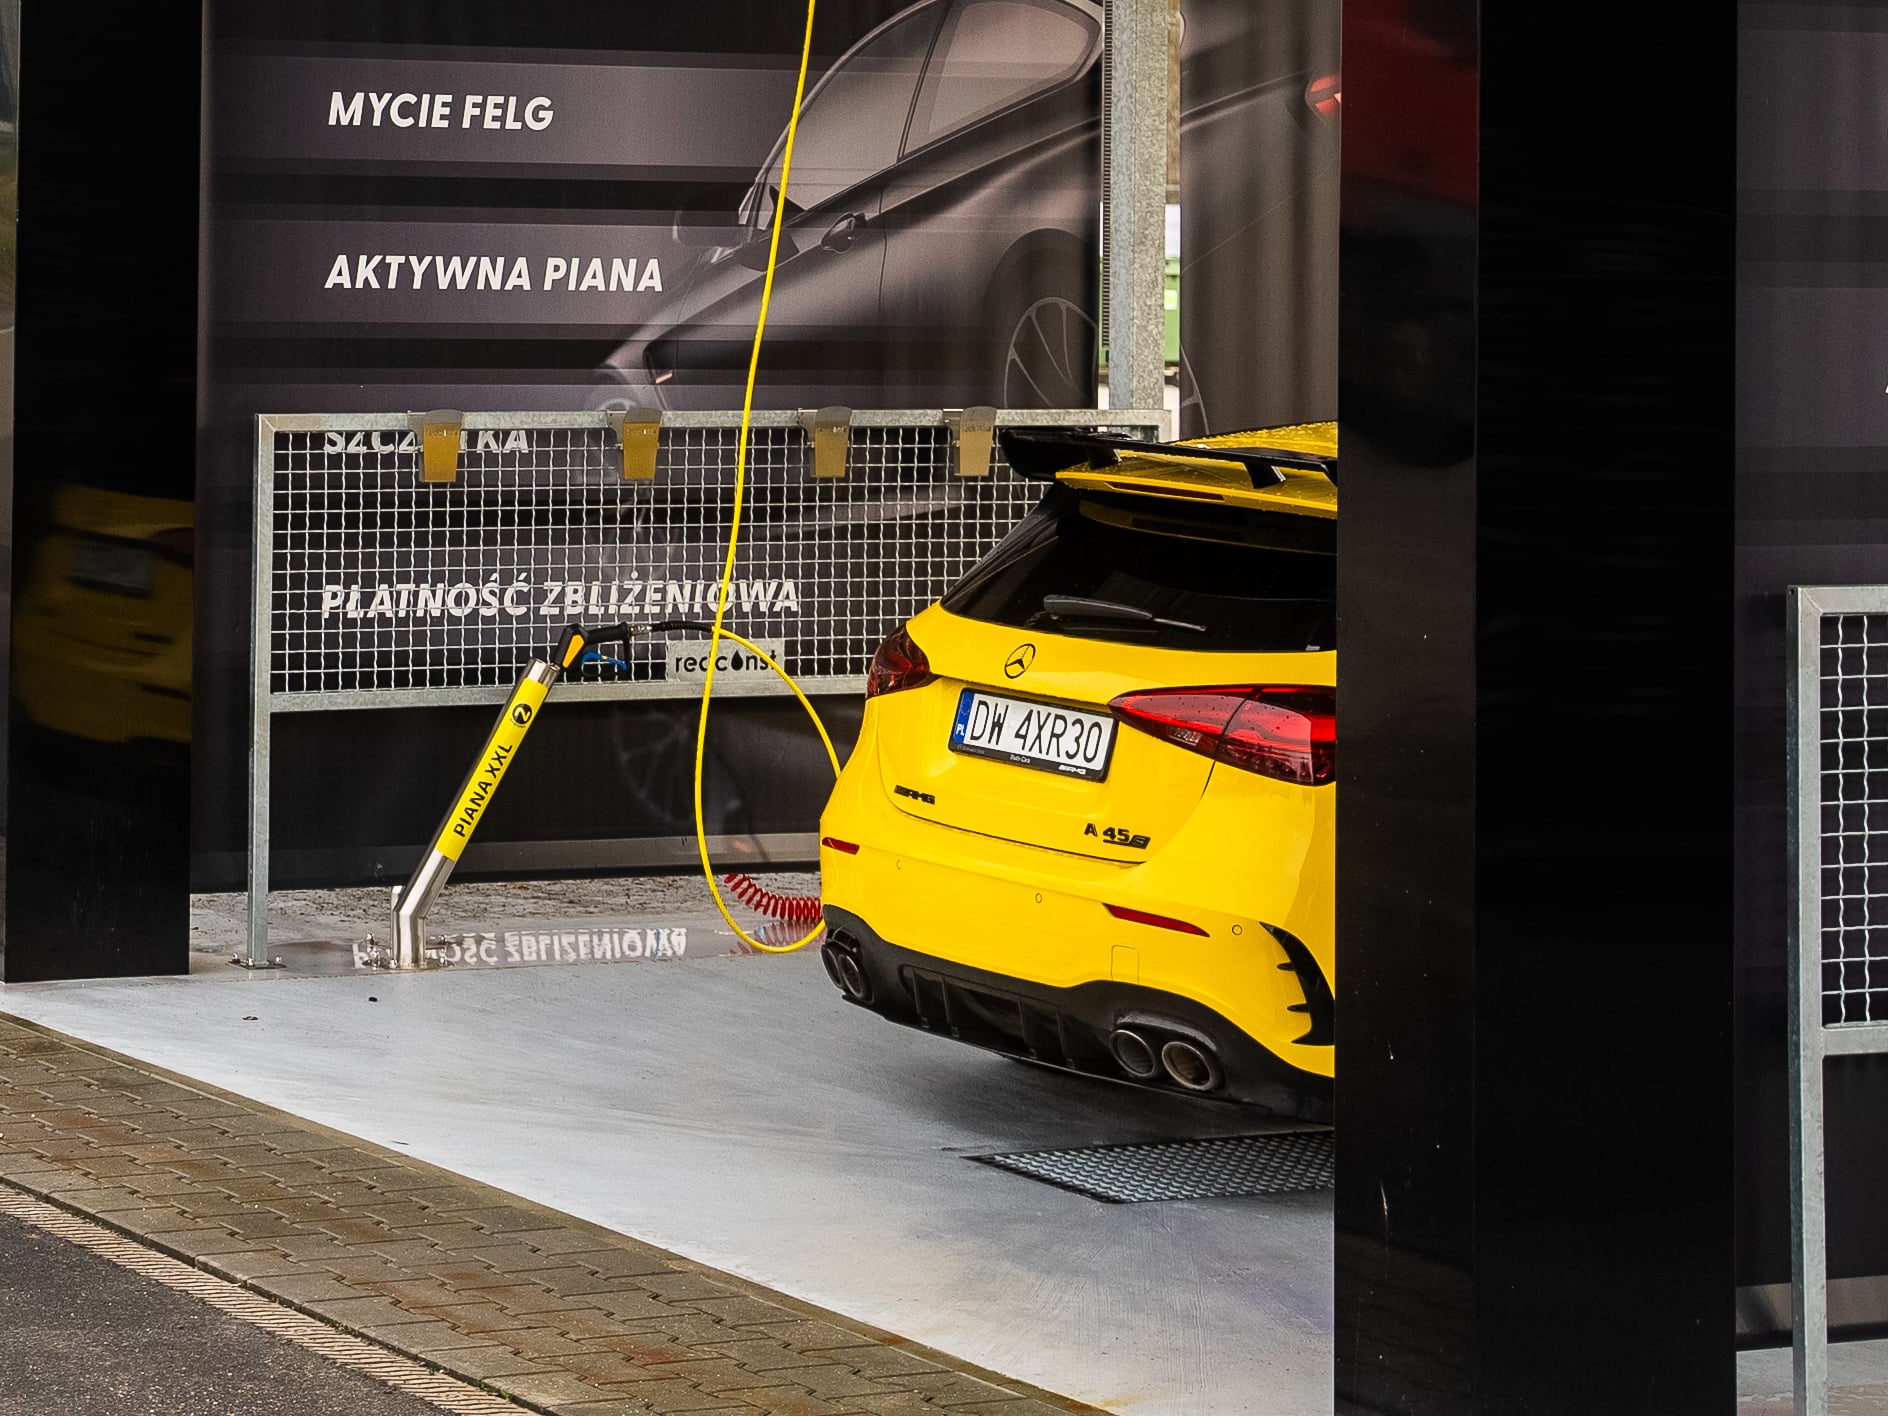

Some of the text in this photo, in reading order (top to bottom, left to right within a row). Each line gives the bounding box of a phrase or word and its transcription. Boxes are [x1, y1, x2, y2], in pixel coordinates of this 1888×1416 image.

[327, 91, 555, 132] MYCIE FELG
[324, 254, 664, 294] AKTYWNA PIANA
[320, 570, 801, 620] PŁATNOŚĆ ZBLIŻENIOWA
[955, 699, 1104, 764] PL DW 4XR30
[453, 780, 493, 838] PIANA
[484, 743, 513, 779] XXL
[1083, 822, 1098, 838] A
